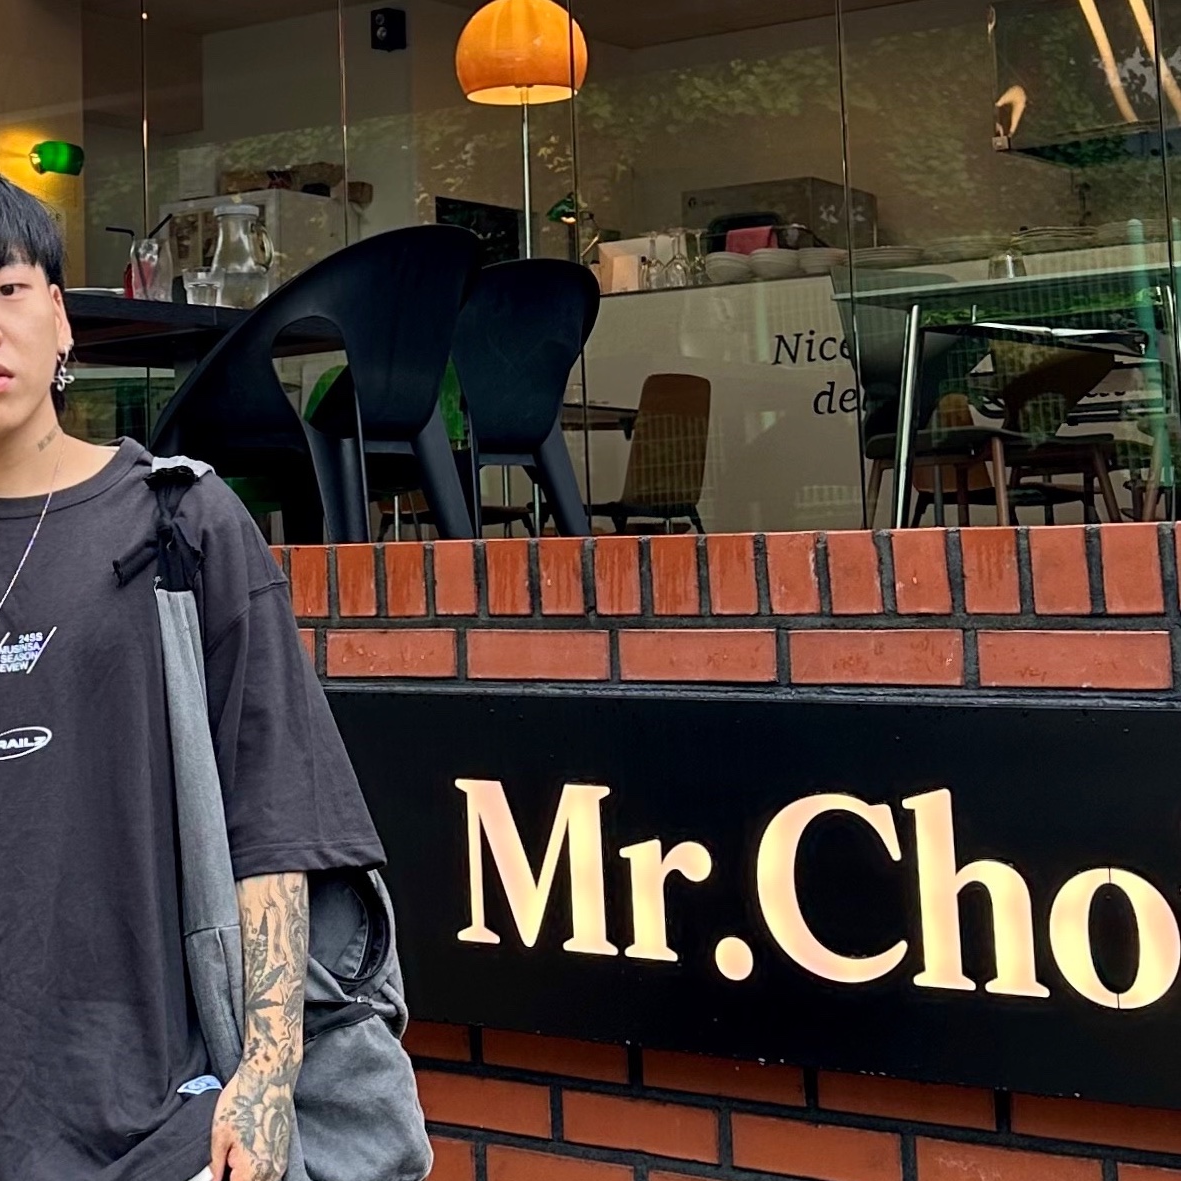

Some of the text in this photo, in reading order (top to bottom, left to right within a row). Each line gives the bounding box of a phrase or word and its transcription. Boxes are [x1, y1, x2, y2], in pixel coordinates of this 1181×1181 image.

[771, 330, 851, 365] Nice
[813, 381, 867, 415] de
[18, 632, 43, 643] 24SS
[0, 651, 39, 663] SEASON
